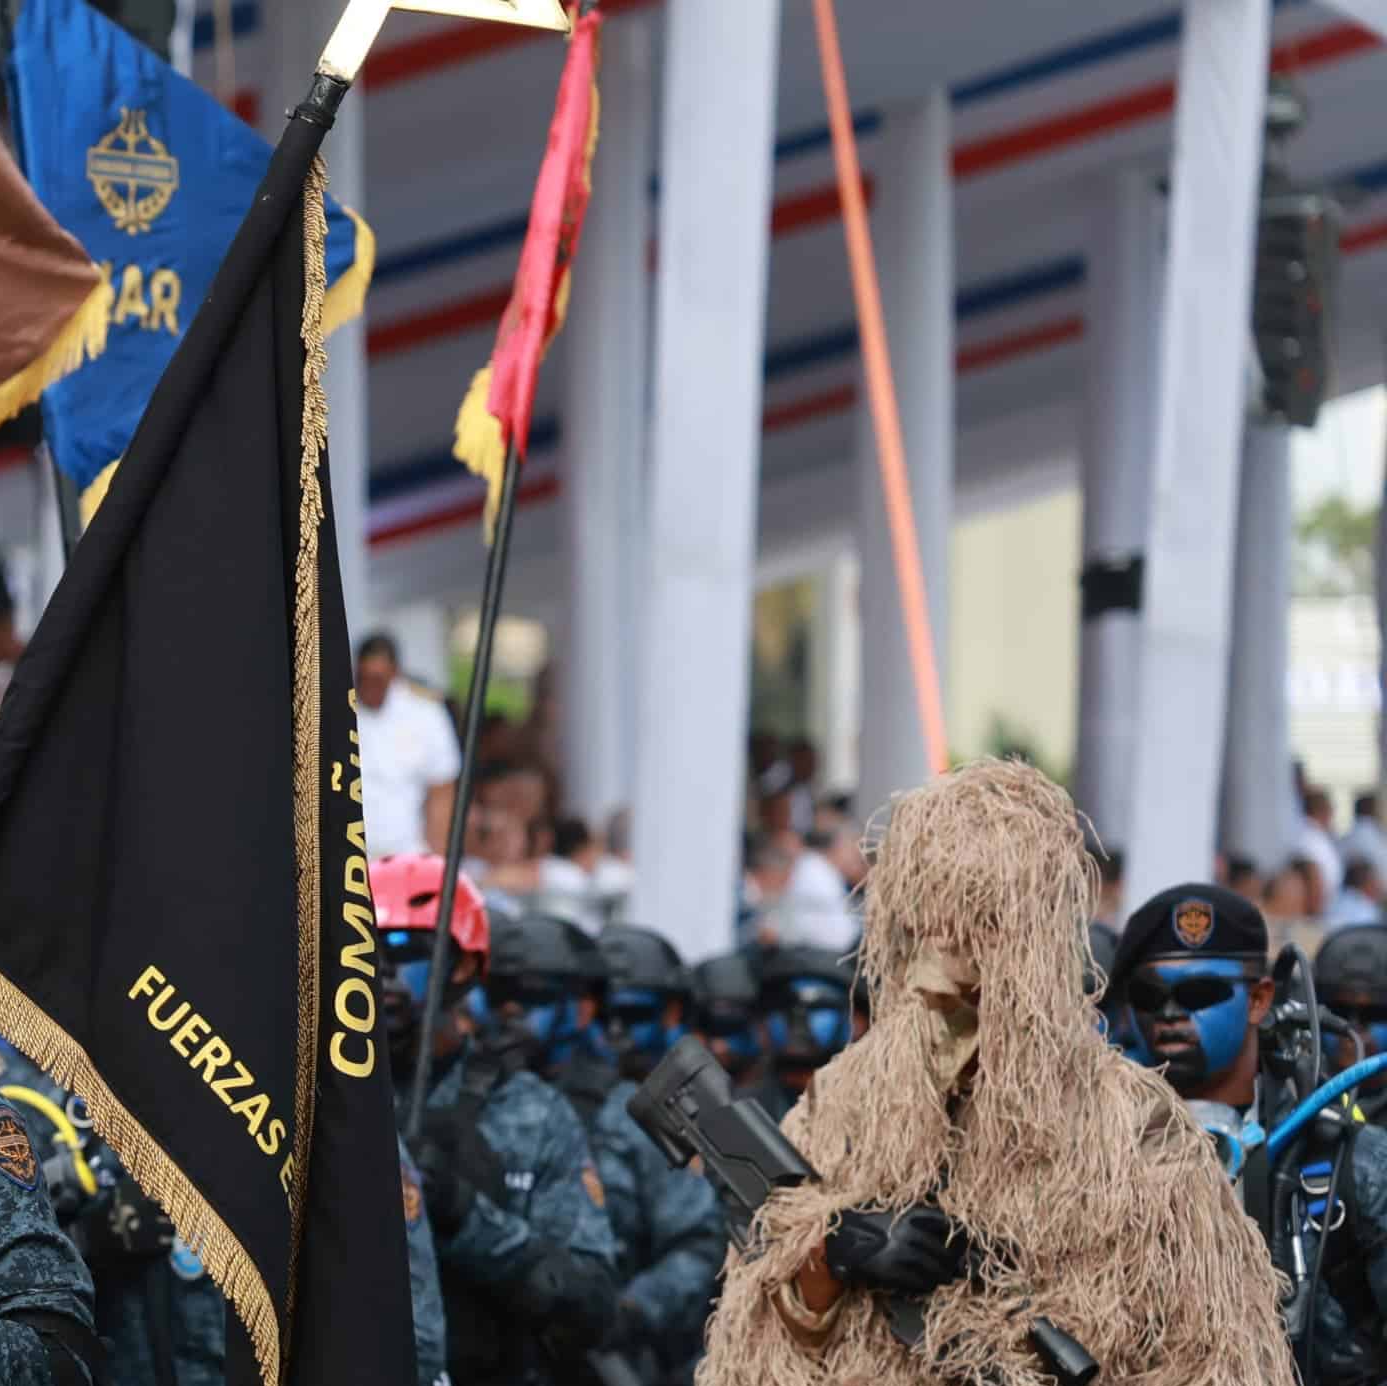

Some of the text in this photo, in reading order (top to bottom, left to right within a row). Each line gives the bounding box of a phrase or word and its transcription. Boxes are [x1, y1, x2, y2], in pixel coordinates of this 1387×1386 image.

[99, 261, 181, 336] AR
[330, 687, 376, 1079] COMPA
[128, 965, 287, 1156] FUERZAS
